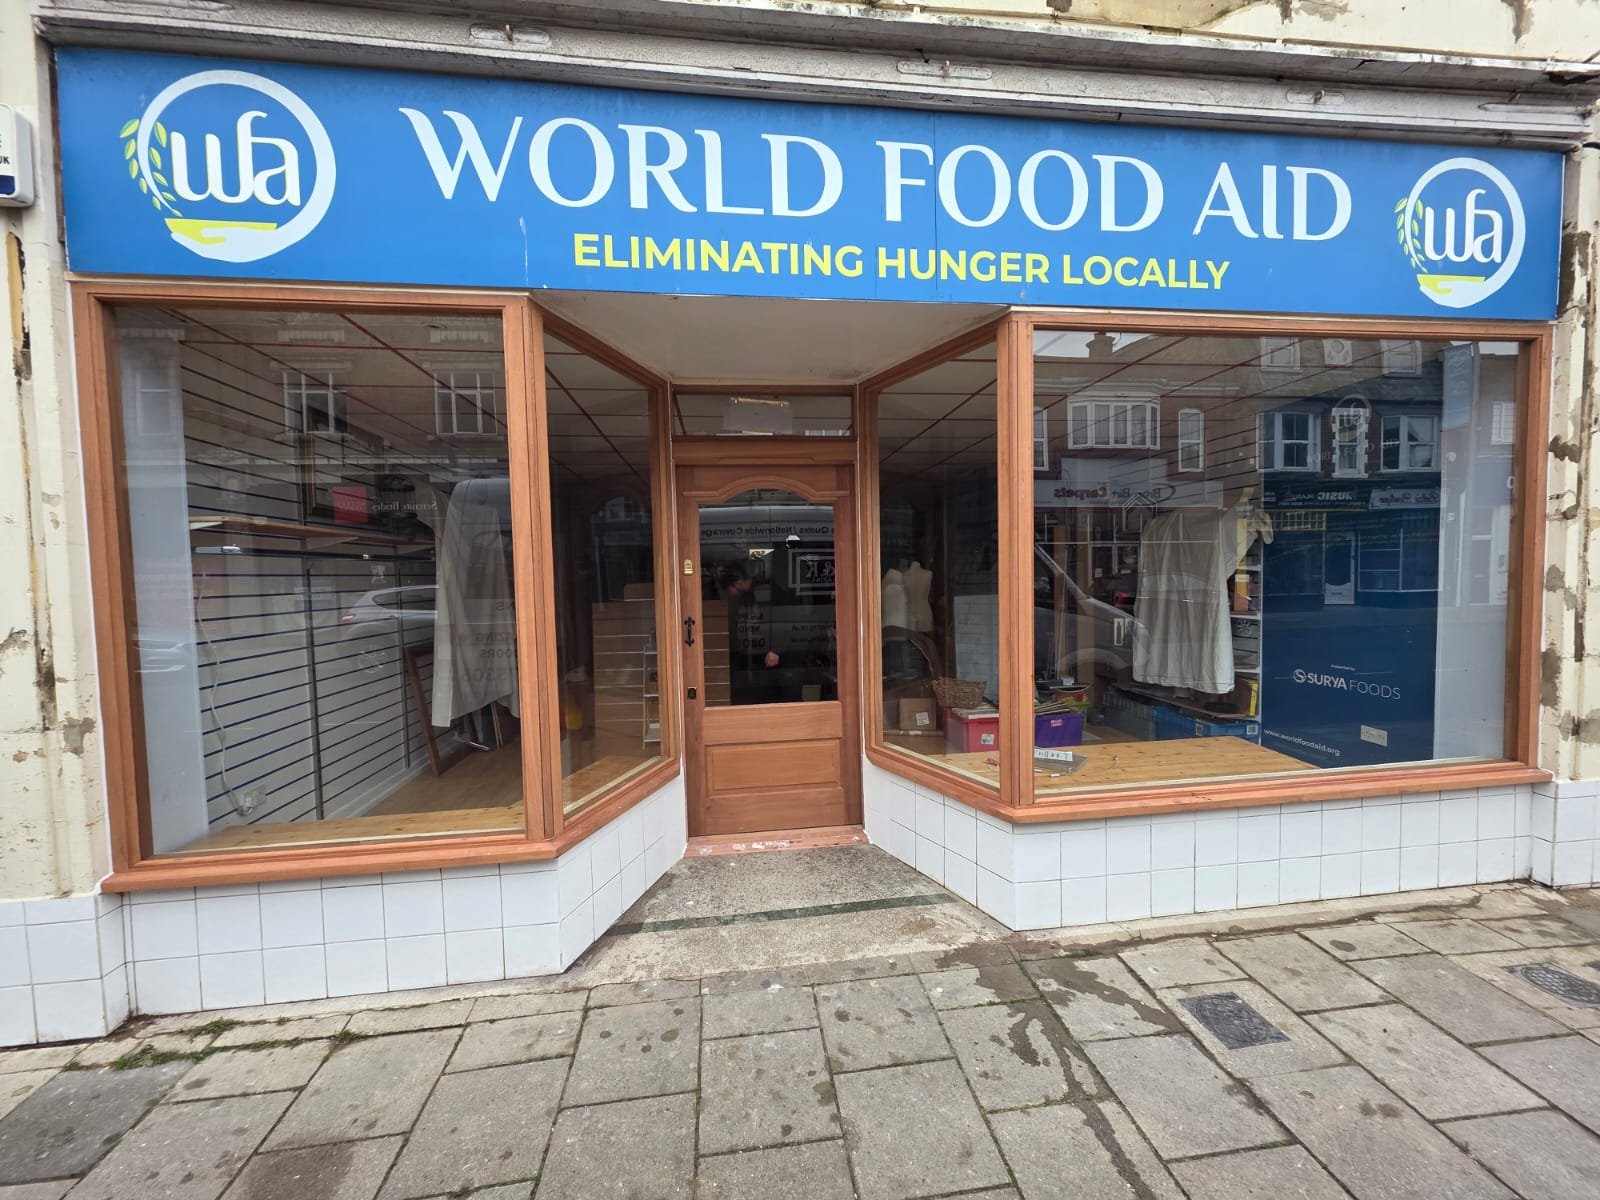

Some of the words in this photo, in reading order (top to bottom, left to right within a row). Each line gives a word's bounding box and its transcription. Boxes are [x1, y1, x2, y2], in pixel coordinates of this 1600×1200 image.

[399, 107, 843, 218] WORLD
[876, 140, 1164, 232] FOOD
[1193, 162, 1352, 241] AID
[573, 232, 863, 279] ELIMINATING
[877, 246, 1050, 285] HUNGER
[1062, 254, 1231, 290] LOCALLY
[1307, 672, 1347, 691] SURYA
[1349, 679, 1401, 700] FOODS
[1263, 728, 1341, 757] www.worldfoodaid.org
